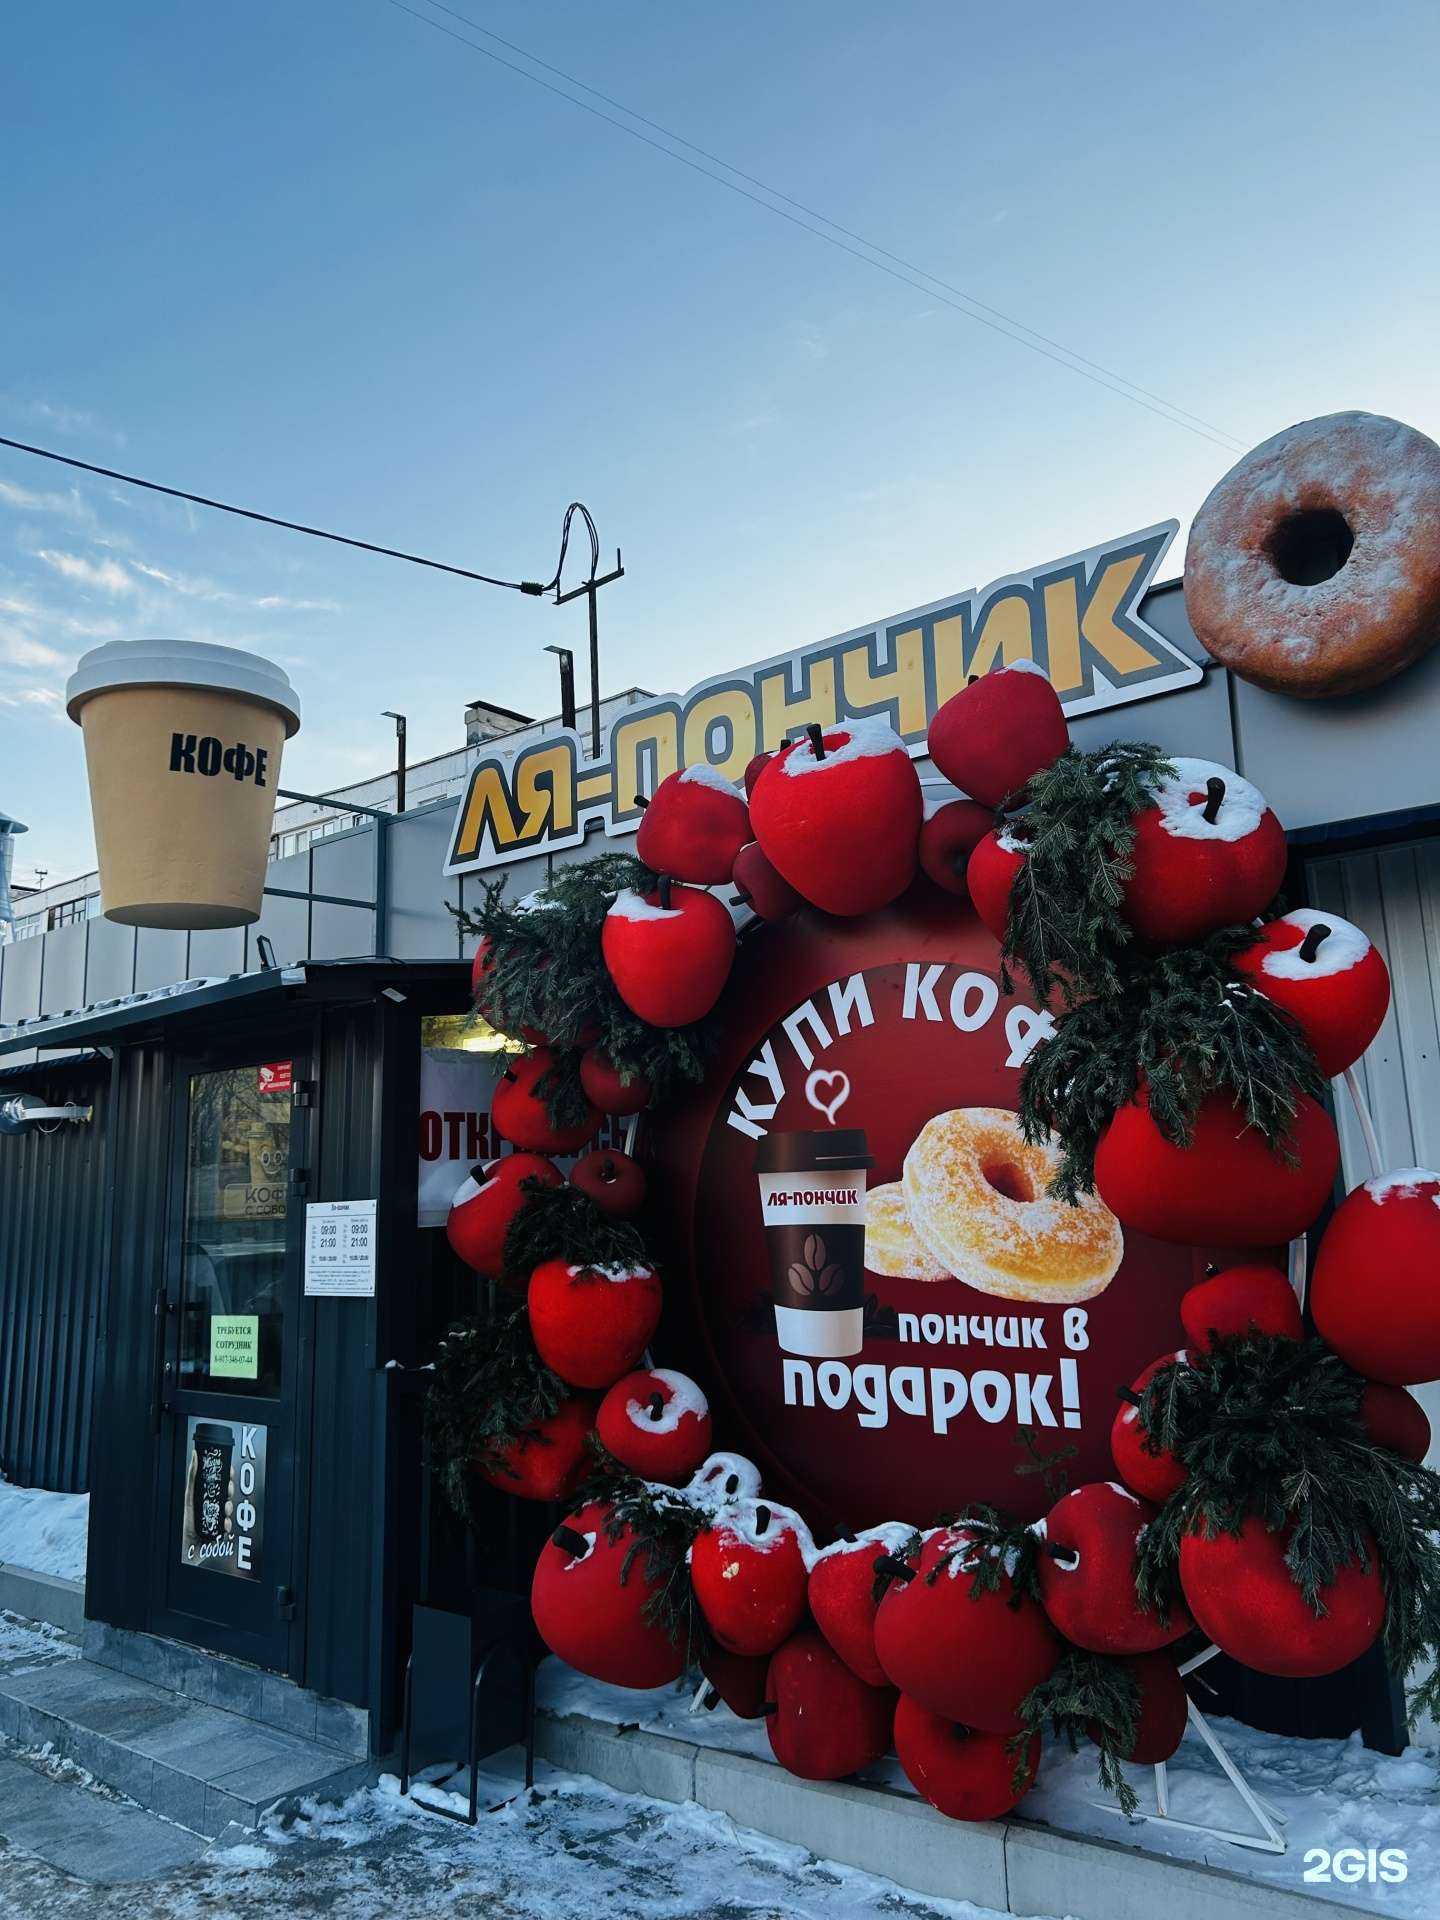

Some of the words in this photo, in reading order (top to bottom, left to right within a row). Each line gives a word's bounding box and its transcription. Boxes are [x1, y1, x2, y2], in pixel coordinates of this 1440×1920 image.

[169, 732, 268, 787] КОФЕ
[727, 971, 875, 1140] КУПИ
[902, 963, 1058, 1069] КОФ
[216, 1326, 252, 1335] ТРЕБУЕТСЯ
[236, 1425, 258, 1570] КОФЕ
[199, 1533, 235, 1558] собой
